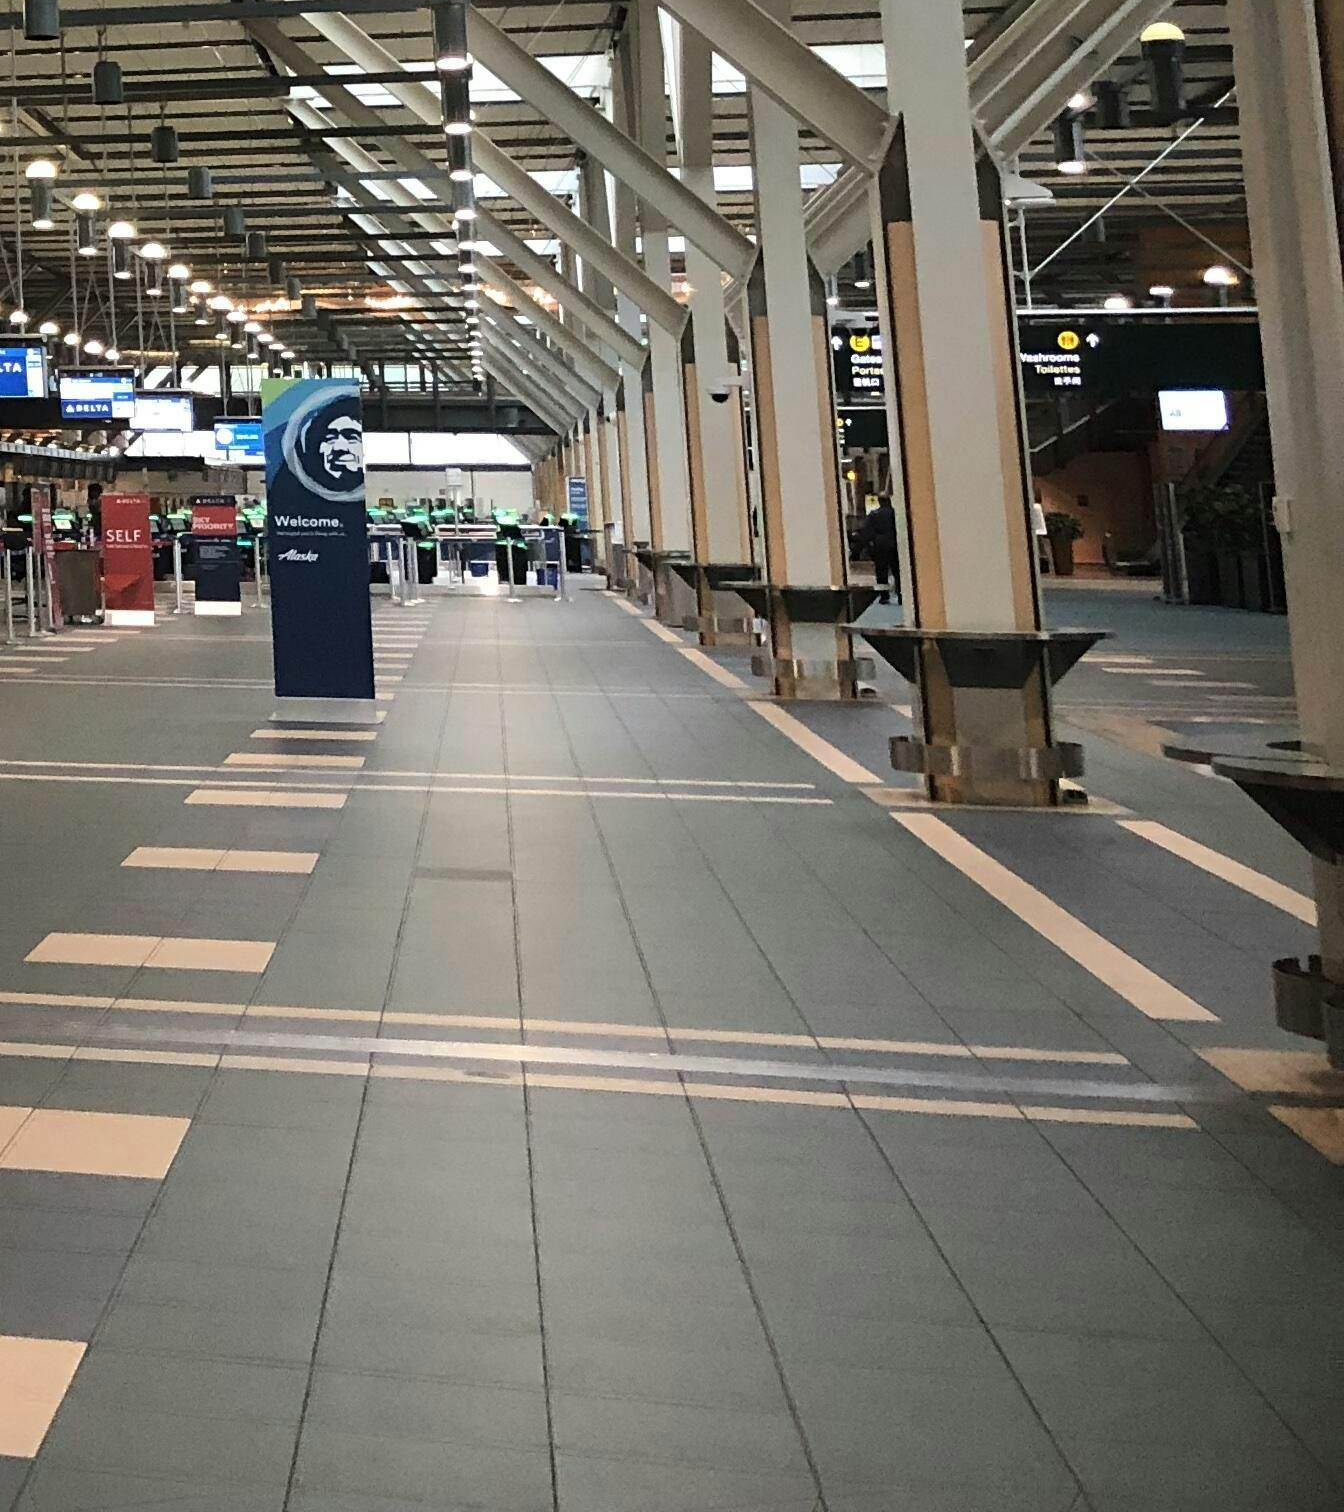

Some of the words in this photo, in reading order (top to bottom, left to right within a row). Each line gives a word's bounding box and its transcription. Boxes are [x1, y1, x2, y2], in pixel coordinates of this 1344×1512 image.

[1034, 365, 1081, 374] Toilettes
[76, 404, 109, 413] DELTA
[106, 529, 141, 543] SELF
[278, 549, 319, 563] Alaska
